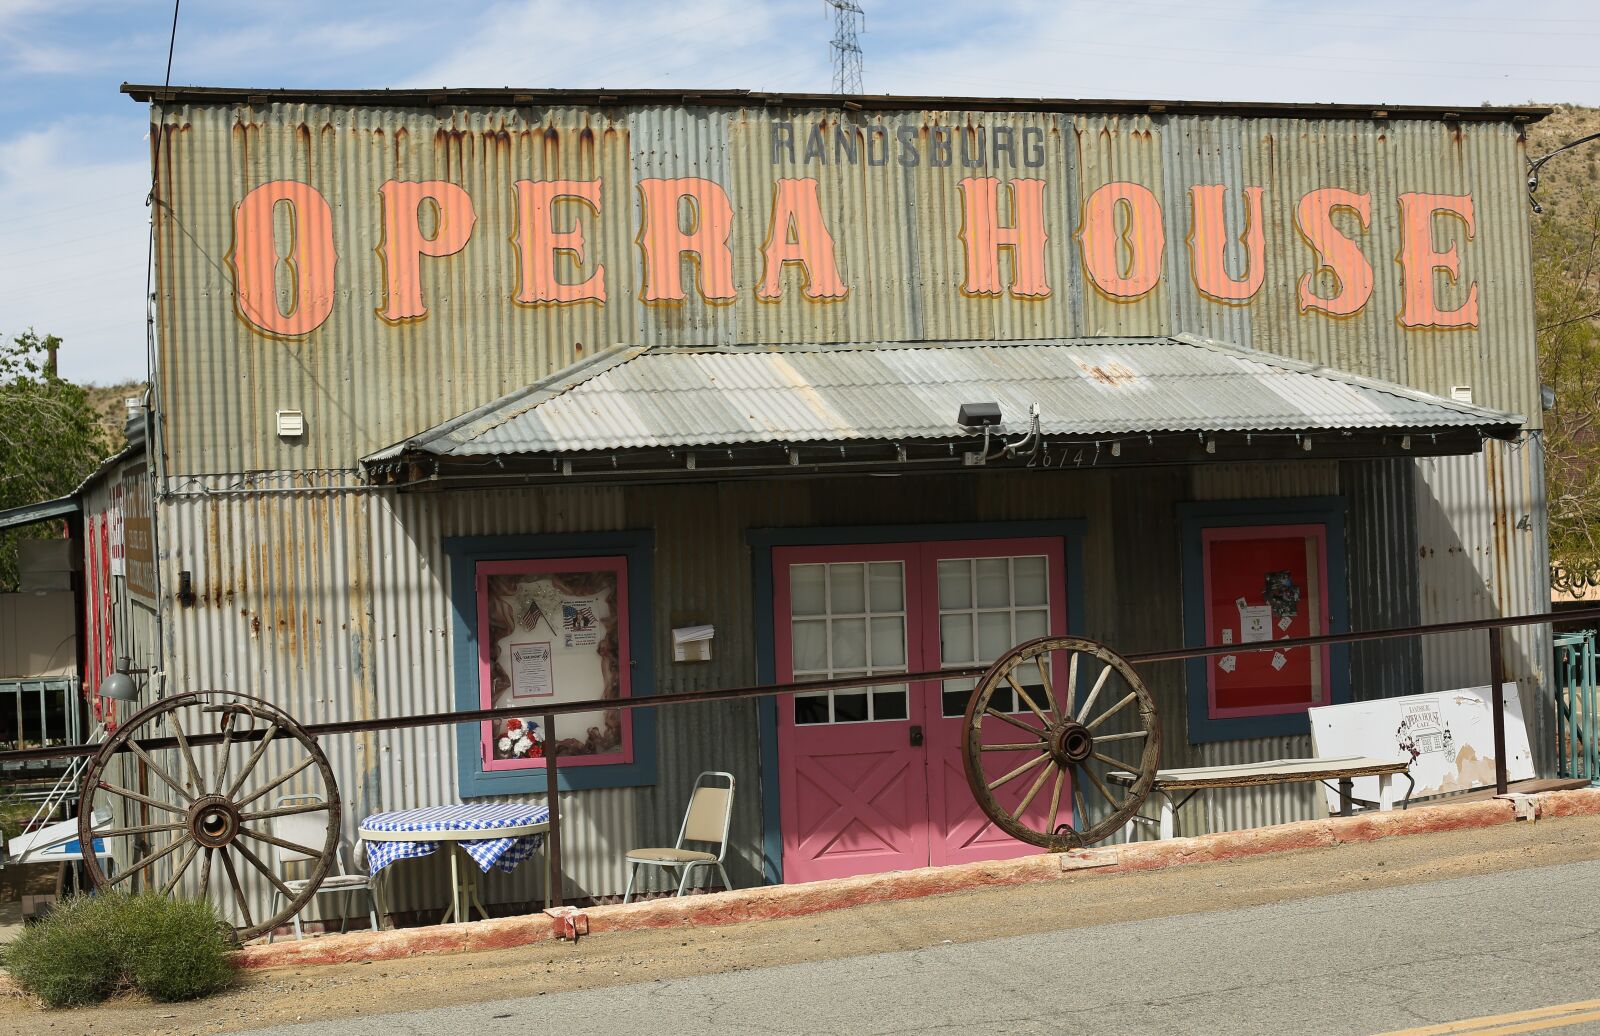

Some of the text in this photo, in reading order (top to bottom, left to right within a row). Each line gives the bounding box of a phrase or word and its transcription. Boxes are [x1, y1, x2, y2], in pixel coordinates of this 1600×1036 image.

[772, 122, 1044, 168] RANDSBURG
[224, 176, 1480, 340] OPERA HOUSE
